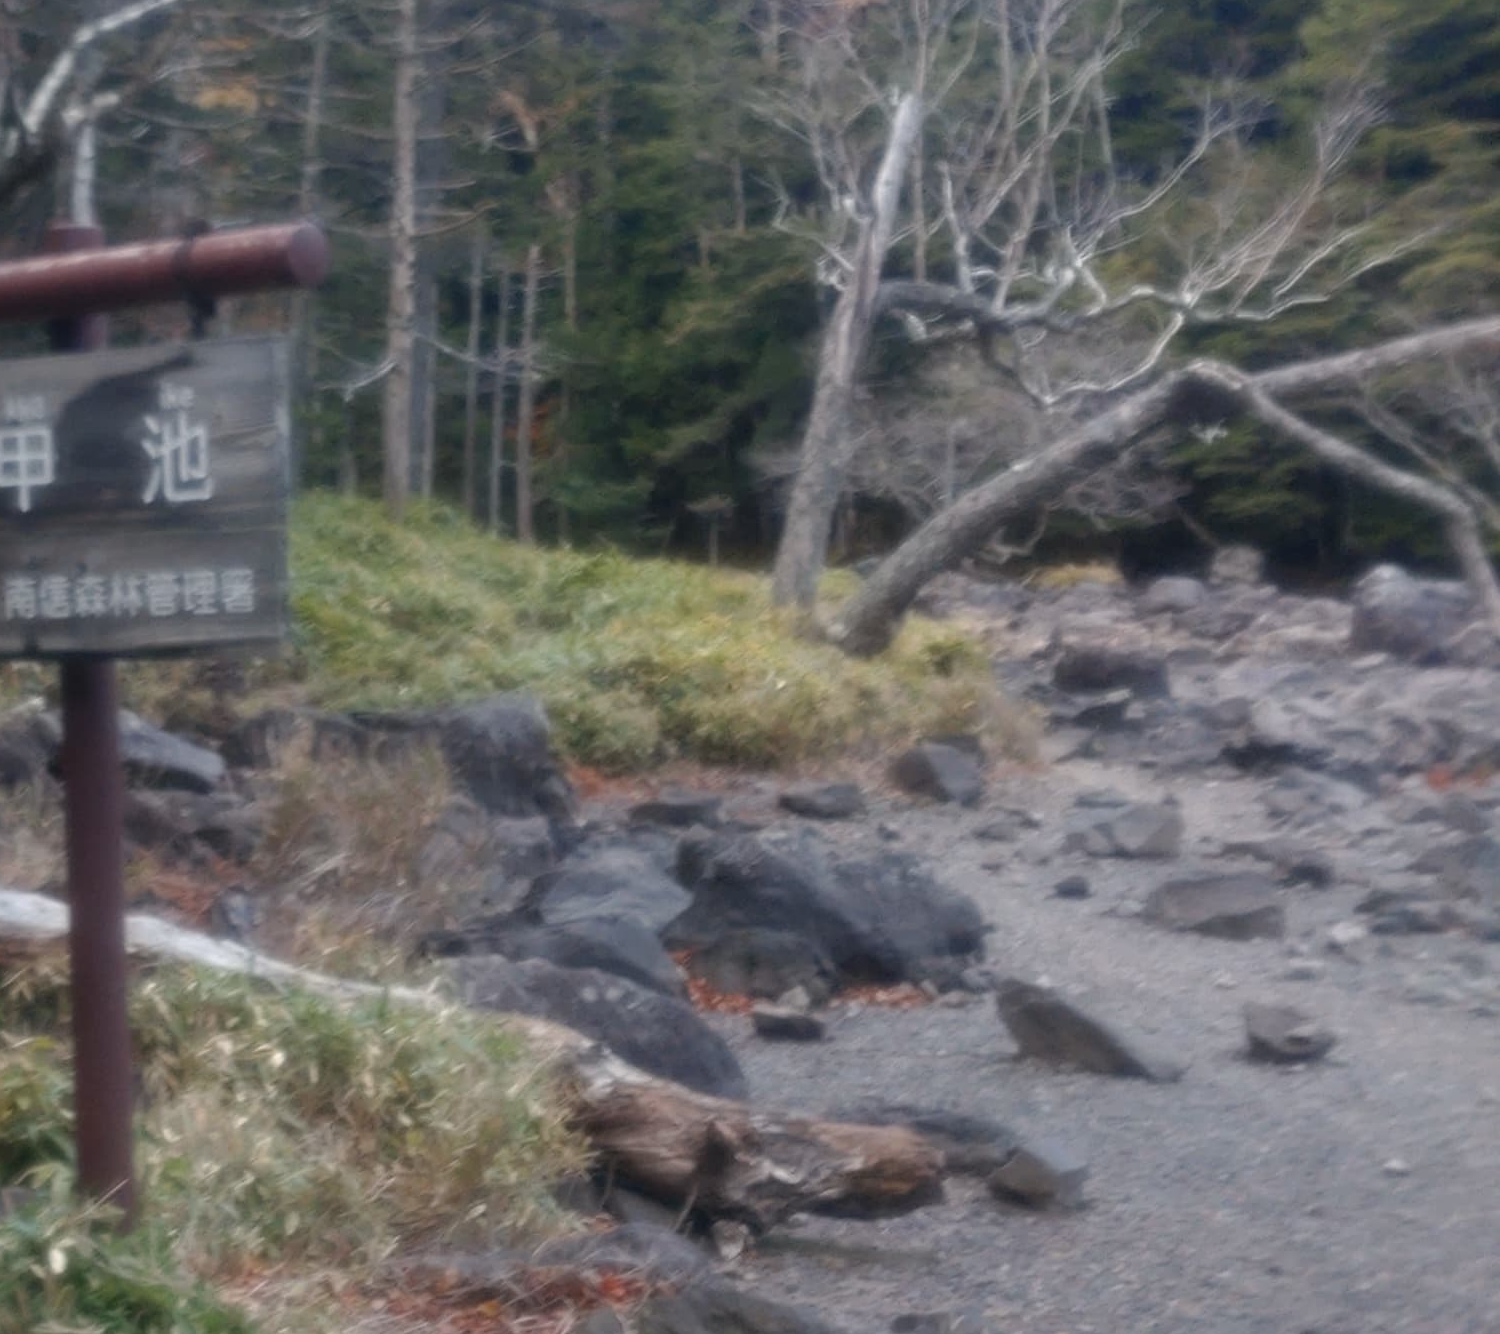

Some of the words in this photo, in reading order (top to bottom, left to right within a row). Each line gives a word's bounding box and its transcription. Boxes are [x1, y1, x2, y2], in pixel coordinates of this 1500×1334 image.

[5, 568, 255, 620] 南信森林管理署
